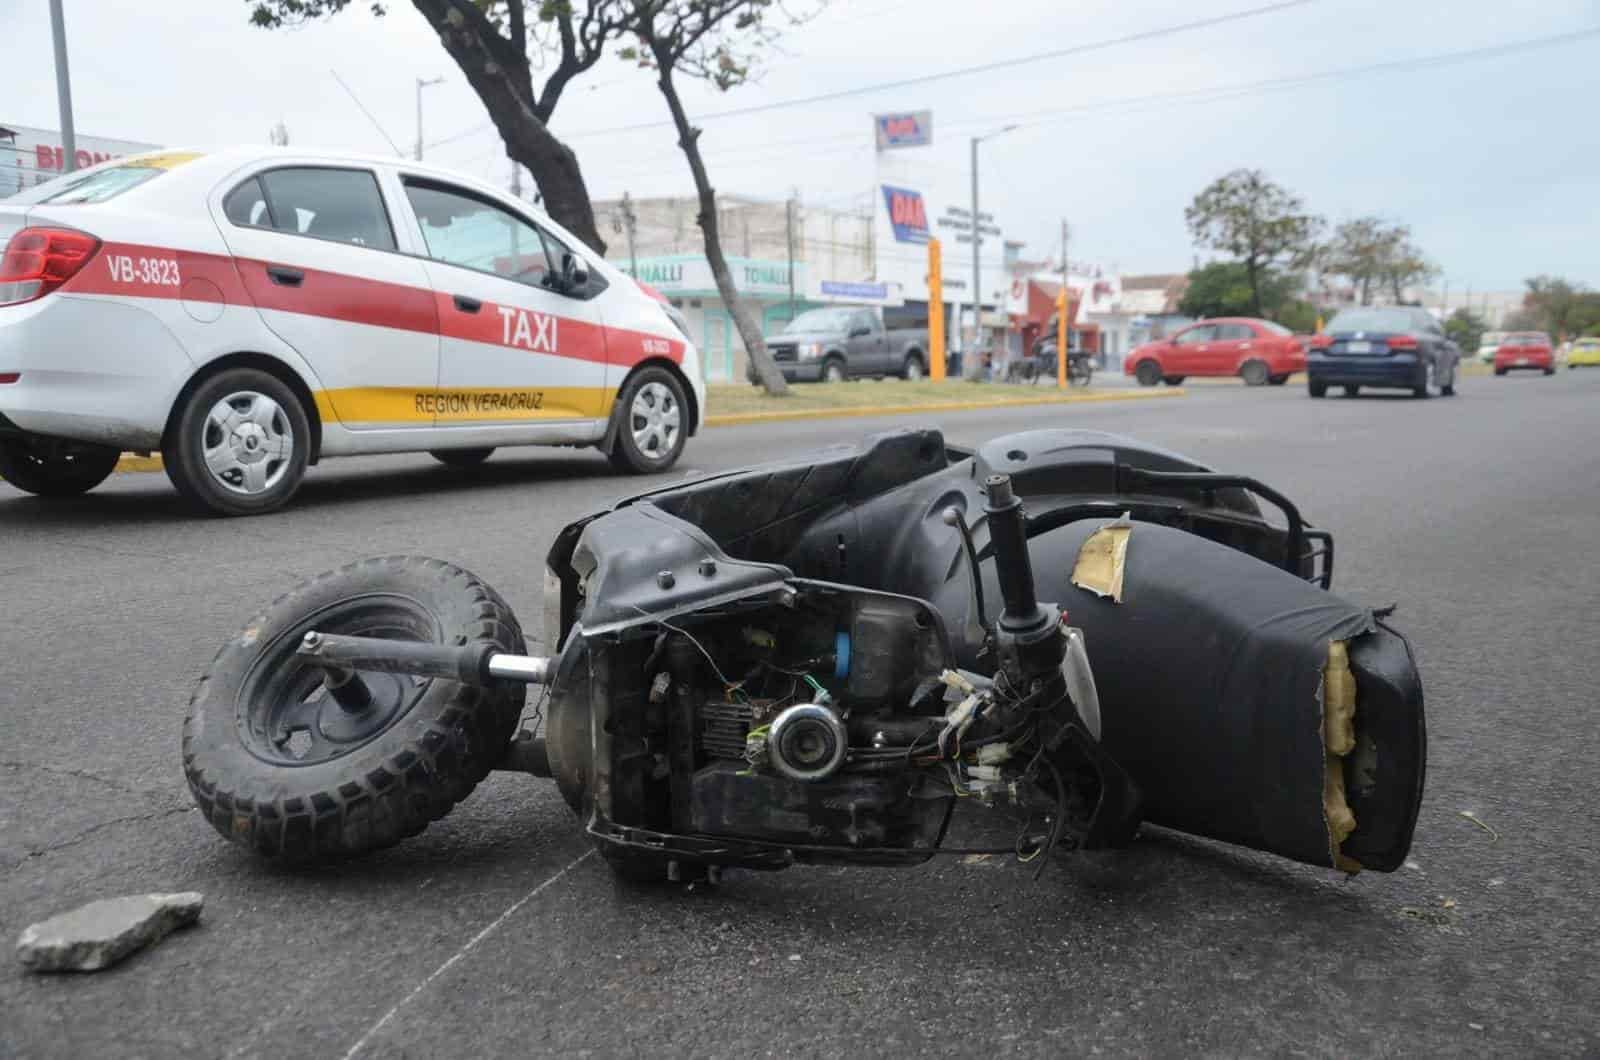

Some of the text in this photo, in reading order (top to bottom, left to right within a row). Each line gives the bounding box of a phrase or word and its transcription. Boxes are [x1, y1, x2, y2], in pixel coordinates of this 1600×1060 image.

[106, 255, 181, 286] VB-3823
[497, 306, 558, 353] TAXI
[415, 391, 544, 413] REGION VERACRUZ
